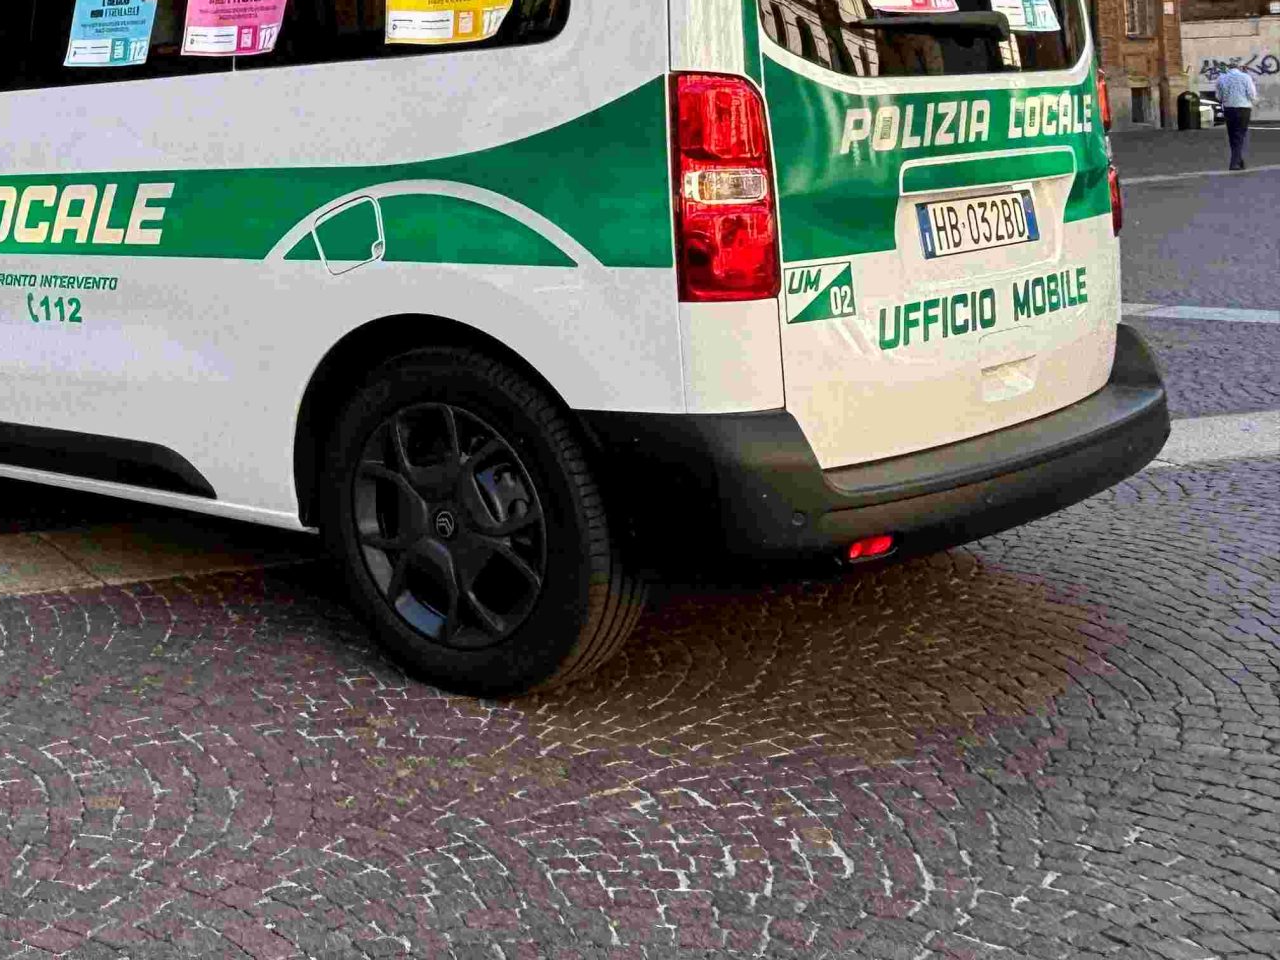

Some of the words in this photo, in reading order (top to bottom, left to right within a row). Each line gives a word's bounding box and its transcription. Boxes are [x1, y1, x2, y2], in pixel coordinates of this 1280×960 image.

[840, 99, 991, 155] POLIZIA
[1008, 90, 1092, 139] LOCALE
[40, 274, 118, 290] INTERVENTO
[788, 268, 822, 295] UM
[39, 295, 83, 324] 112
[829, 284, 853, 316] 02
[878, 287, 996, 351] UFFICIO
[1012, 266, 1089, 322] MOBILE
